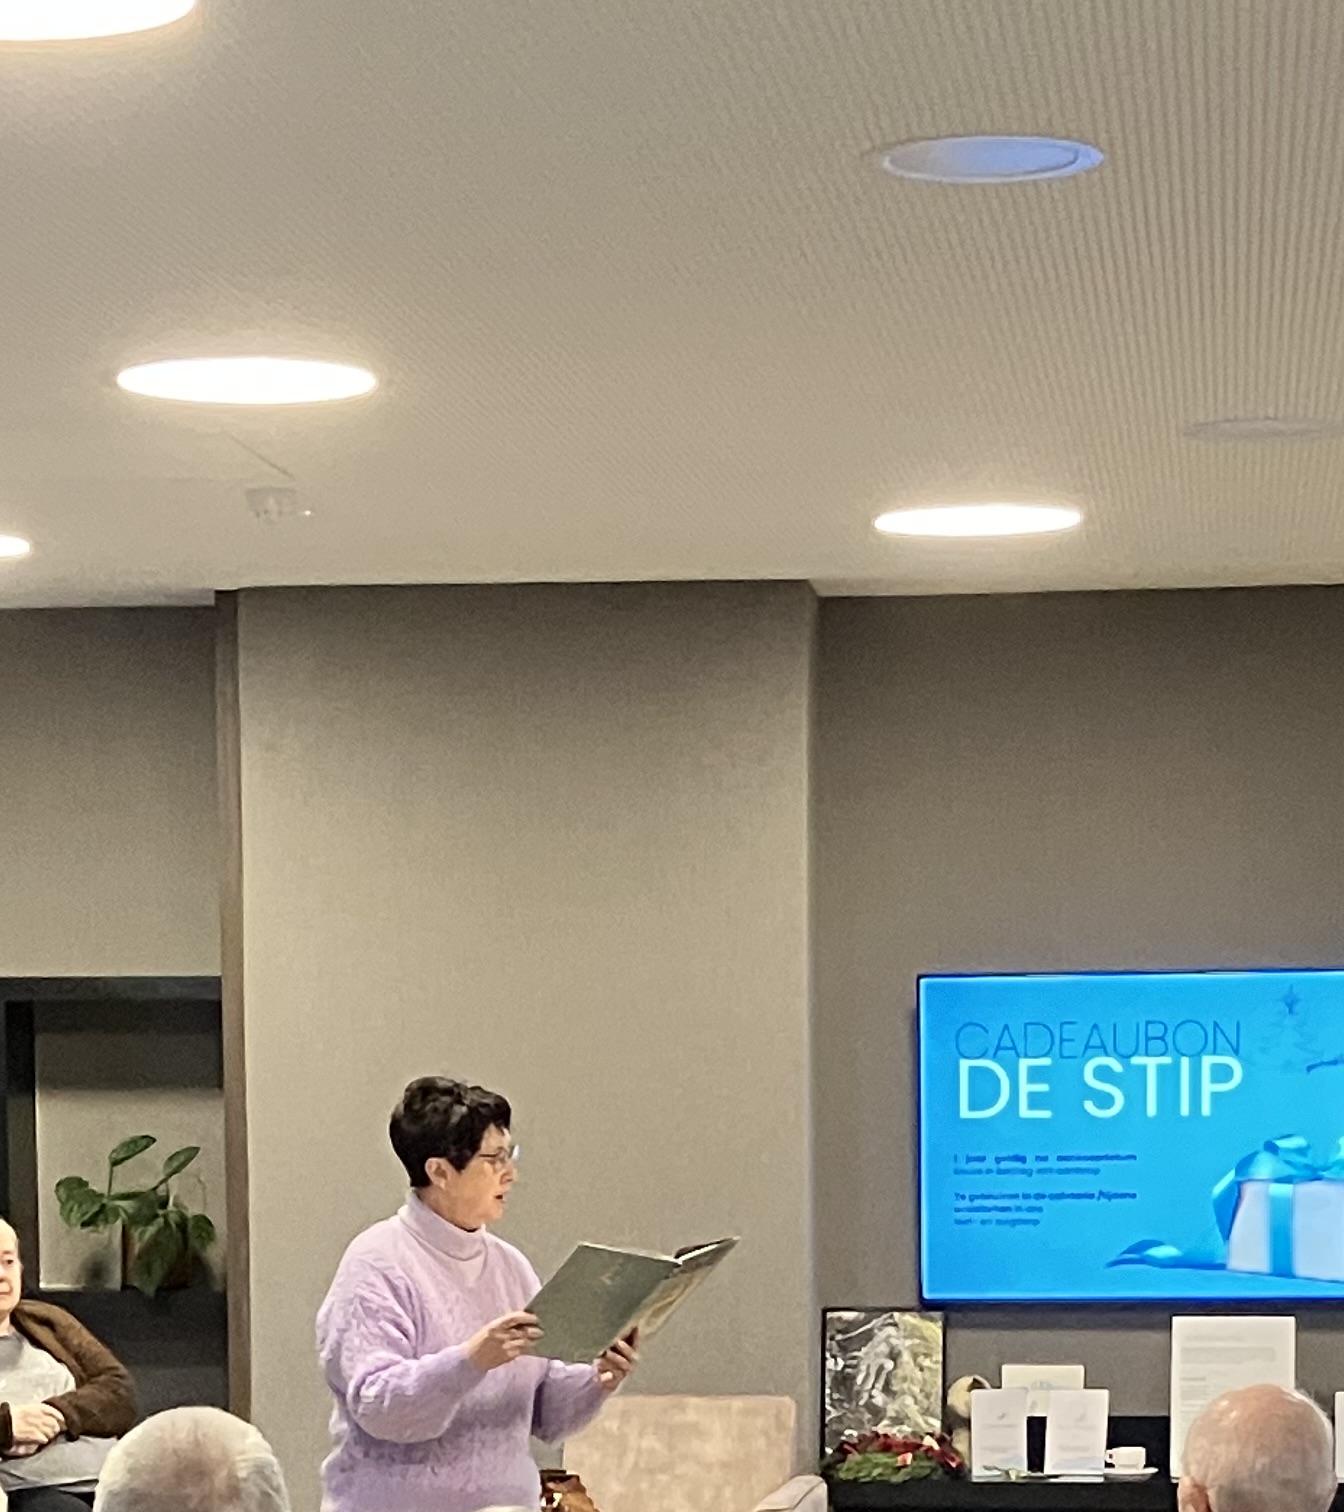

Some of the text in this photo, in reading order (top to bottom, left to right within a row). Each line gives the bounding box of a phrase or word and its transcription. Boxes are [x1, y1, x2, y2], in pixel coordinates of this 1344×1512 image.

[955, 1018, 1241, 1060] CADEAUBON
[958, 1054, 1244, 1119] DE STIP
